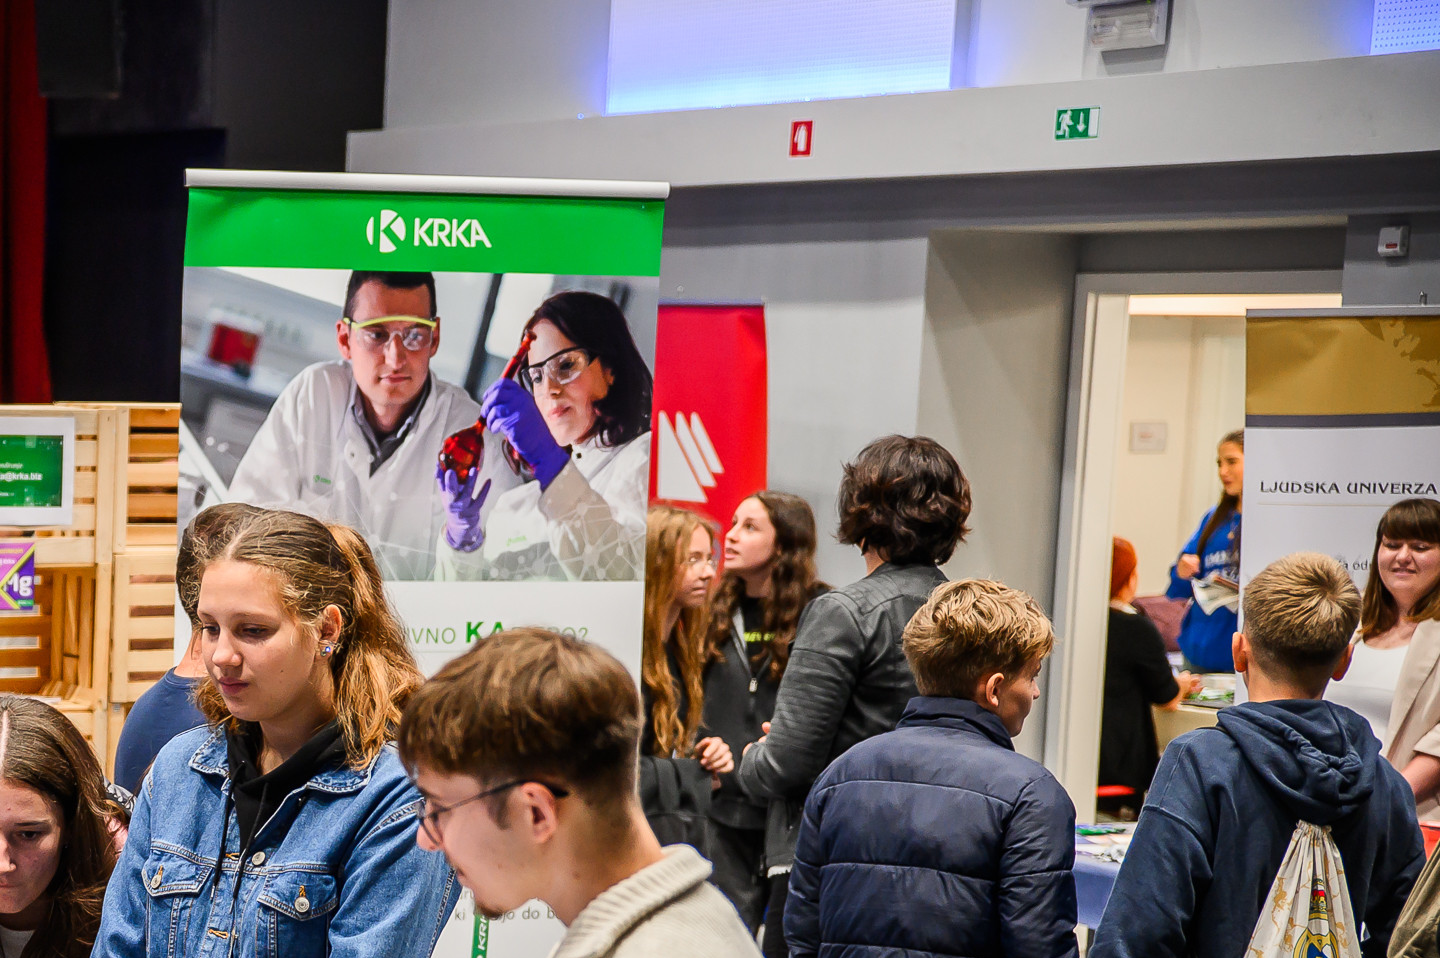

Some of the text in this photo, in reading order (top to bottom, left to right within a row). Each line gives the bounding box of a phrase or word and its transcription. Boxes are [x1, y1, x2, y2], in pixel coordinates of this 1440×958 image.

[413, 217, 493, 249] KRKA
[1260, 480, 1438, 495] LJUDSKA UNIVERZA
[522, 906, 540, 920] do
